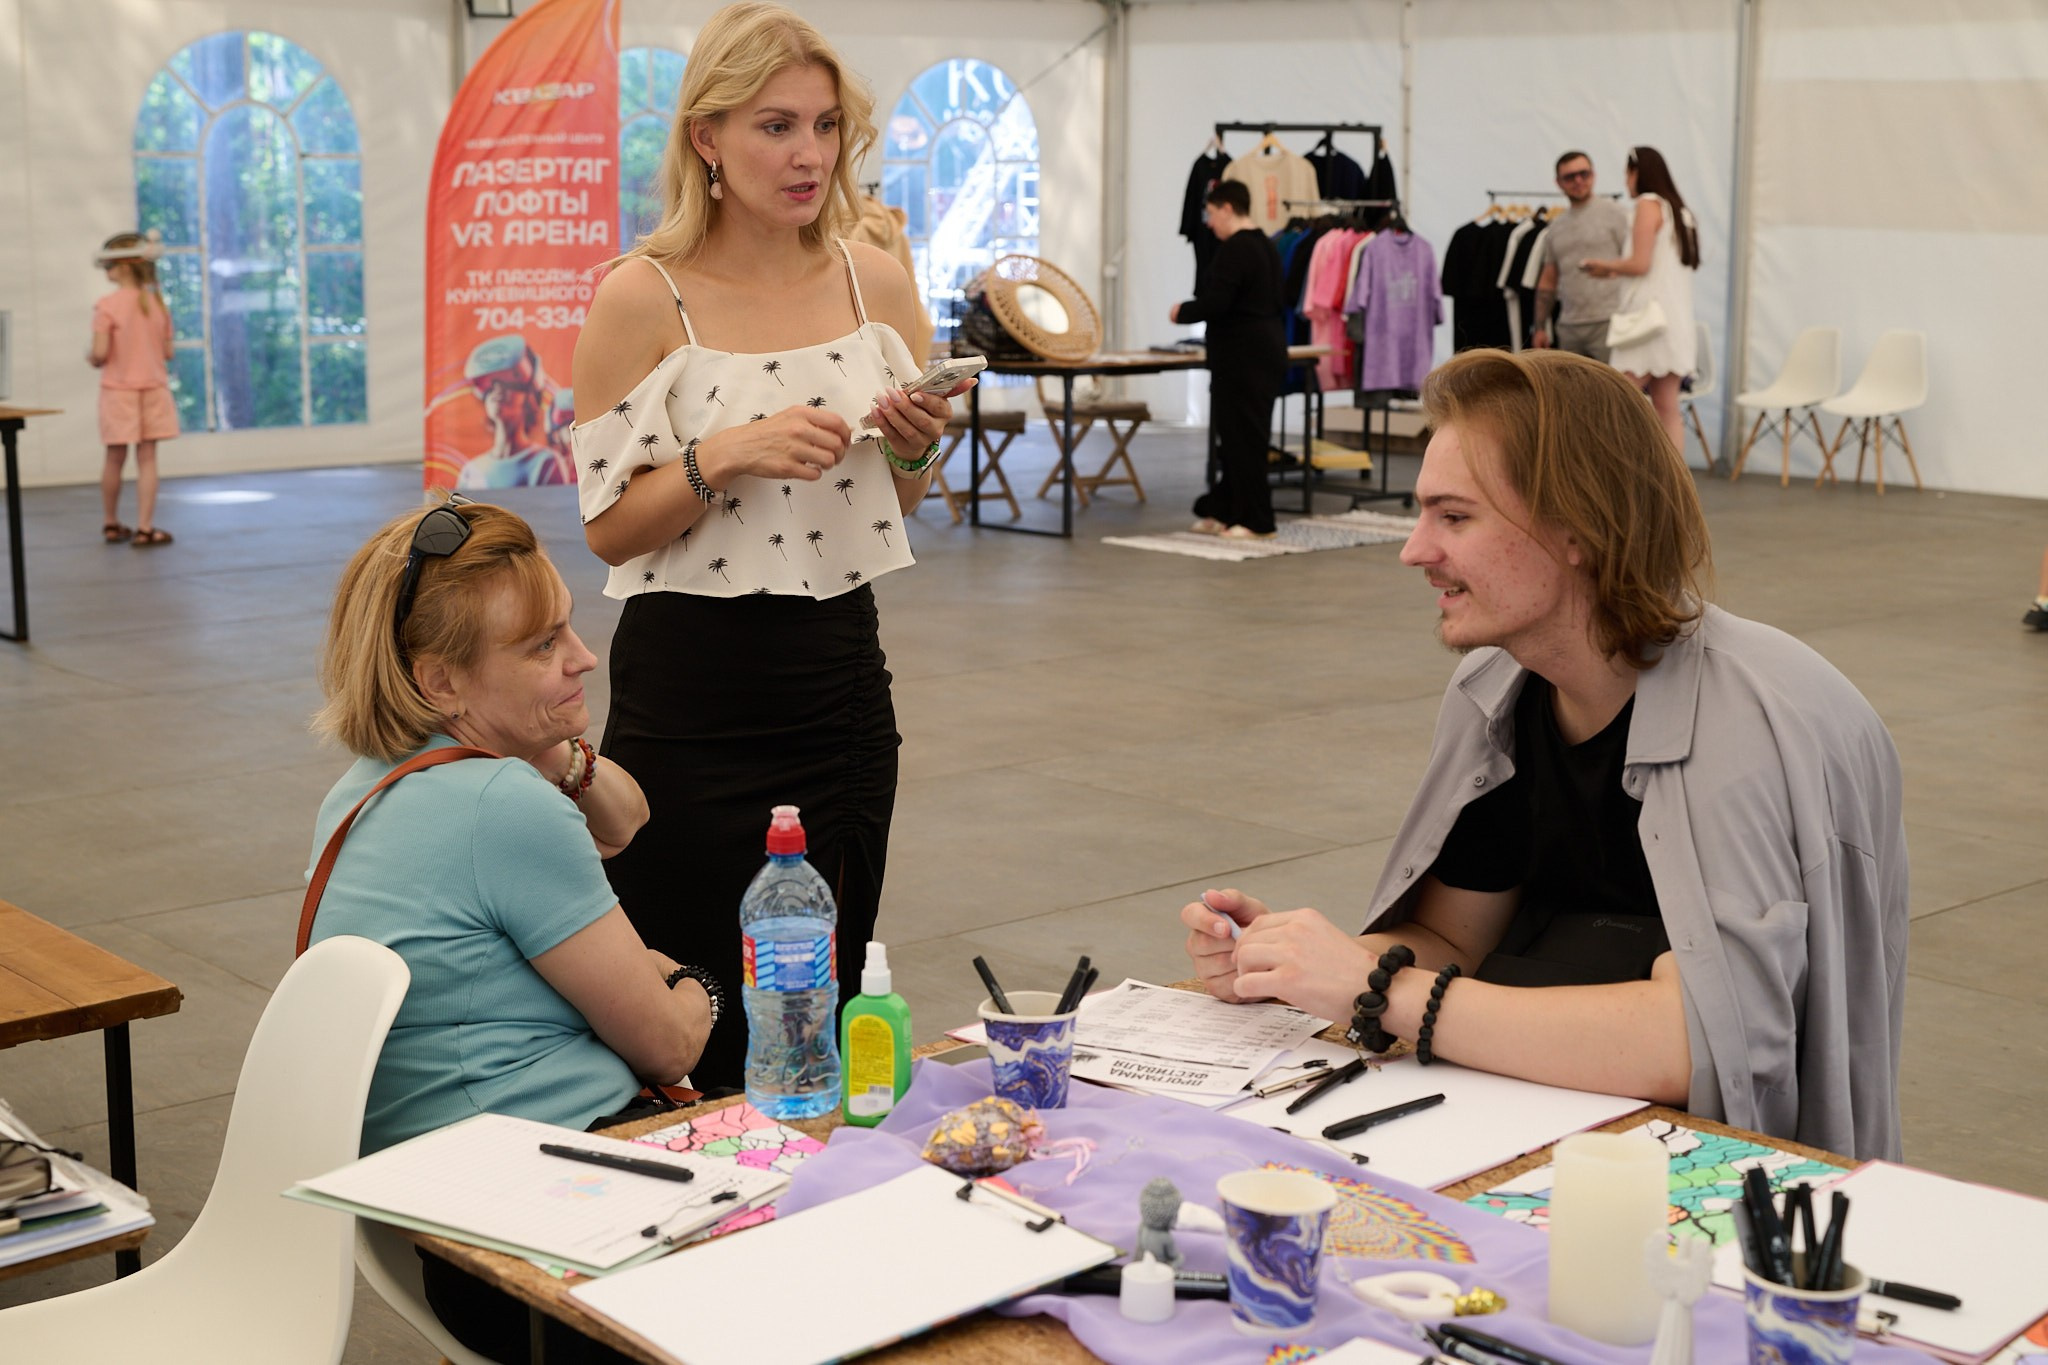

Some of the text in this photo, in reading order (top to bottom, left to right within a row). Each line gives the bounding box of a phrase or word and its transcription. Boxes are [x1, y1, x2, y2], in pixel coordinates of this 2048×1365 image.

[451, 158, 611, 188] ЛАЗЕРТАГ
[473, 190, 588, 217] ЛОФТЫ
[451, 220, 609, 247] VR АРЕНА
[466, 270, 493, 286] ТК
[473, 306, 586, 331] 704-334
[1109, 1067, 1204, 1087] ПРОГРАММА
[1113, 1060, 1209, 1079] ФЕСТИВАЛЯ
